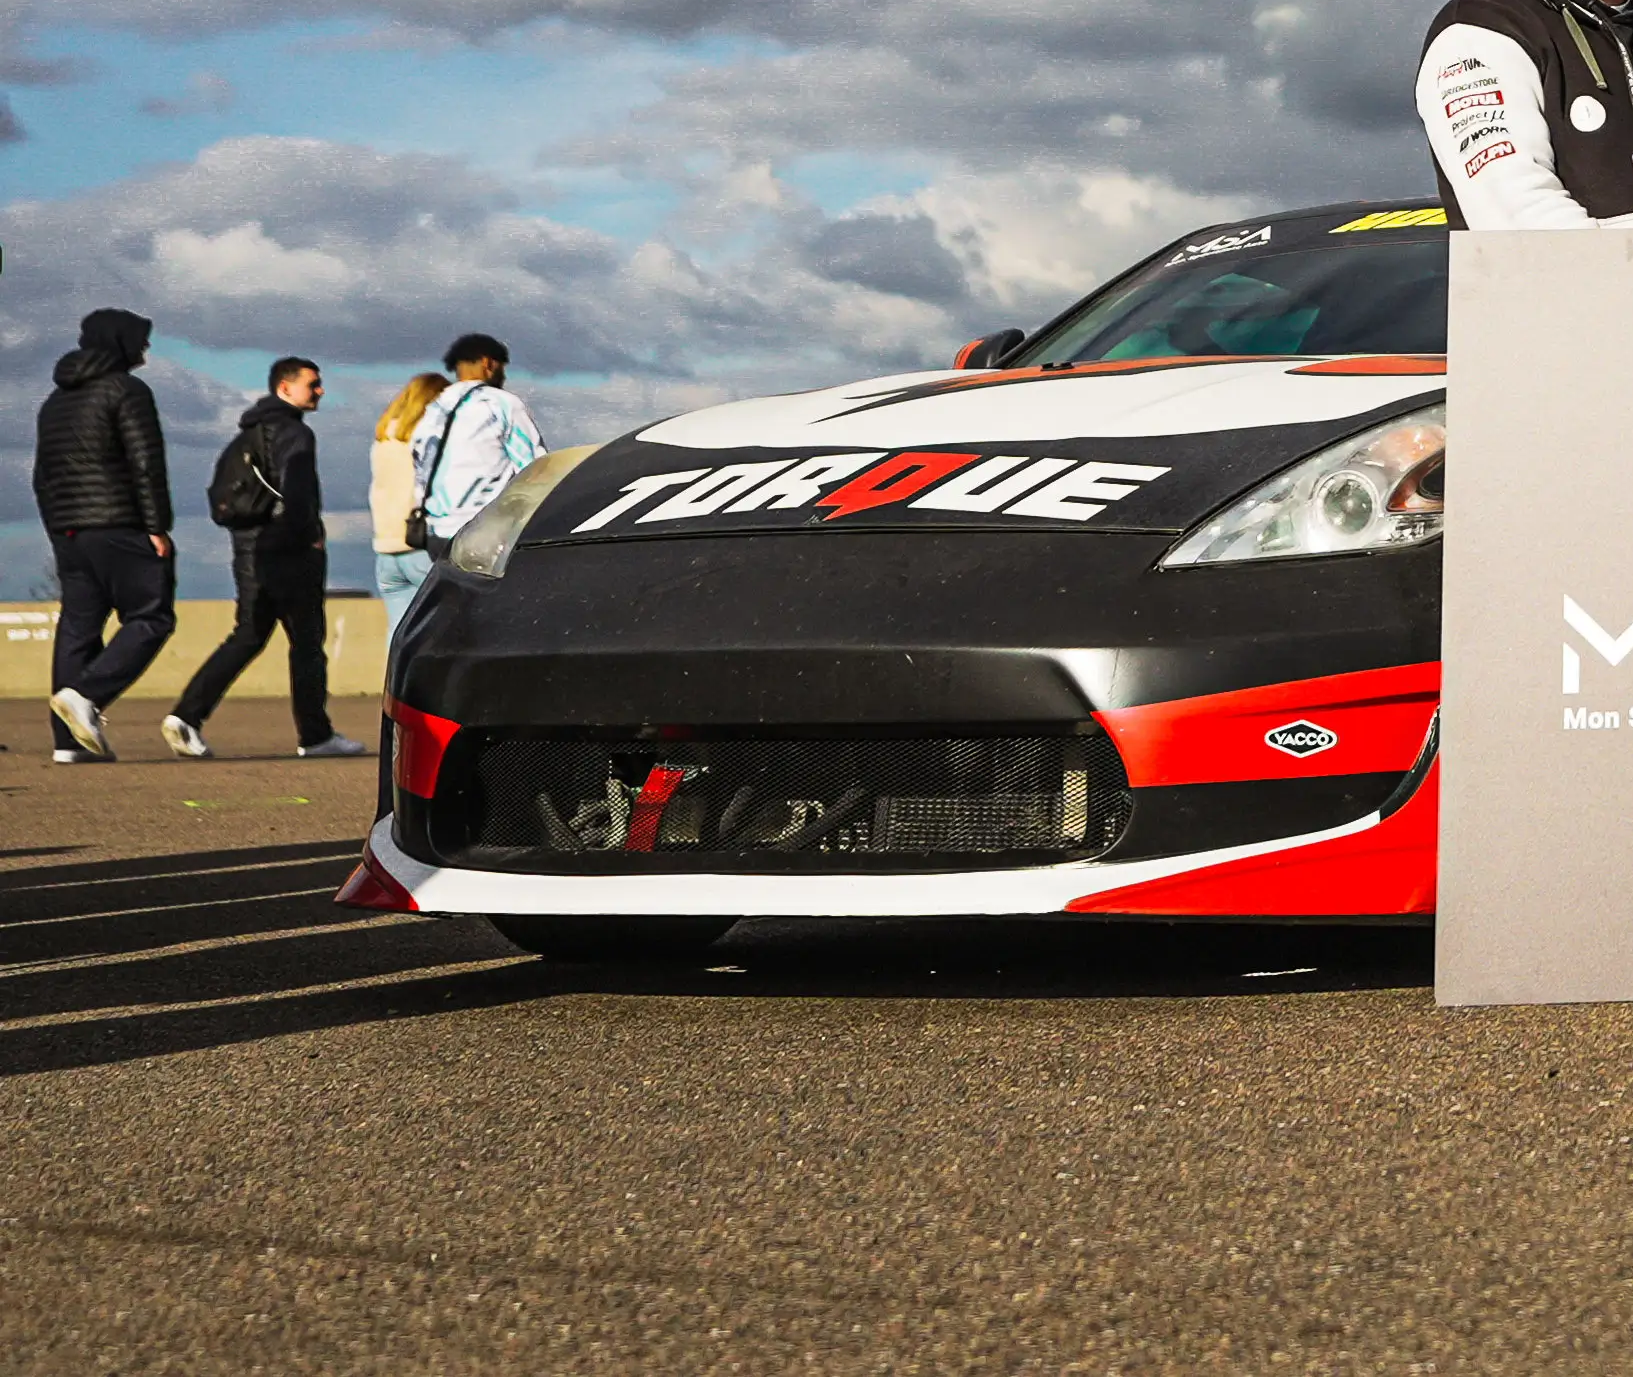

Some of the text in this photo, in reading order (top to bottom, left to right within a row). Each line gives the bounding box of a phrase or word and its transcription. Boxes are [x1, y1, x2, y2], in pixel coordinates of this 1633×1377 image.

[570, 452, 1173, 534] TORQUE
[1563, 707, 1620, 730] Mon
[1274, 732, 1330, 746] YACCO
